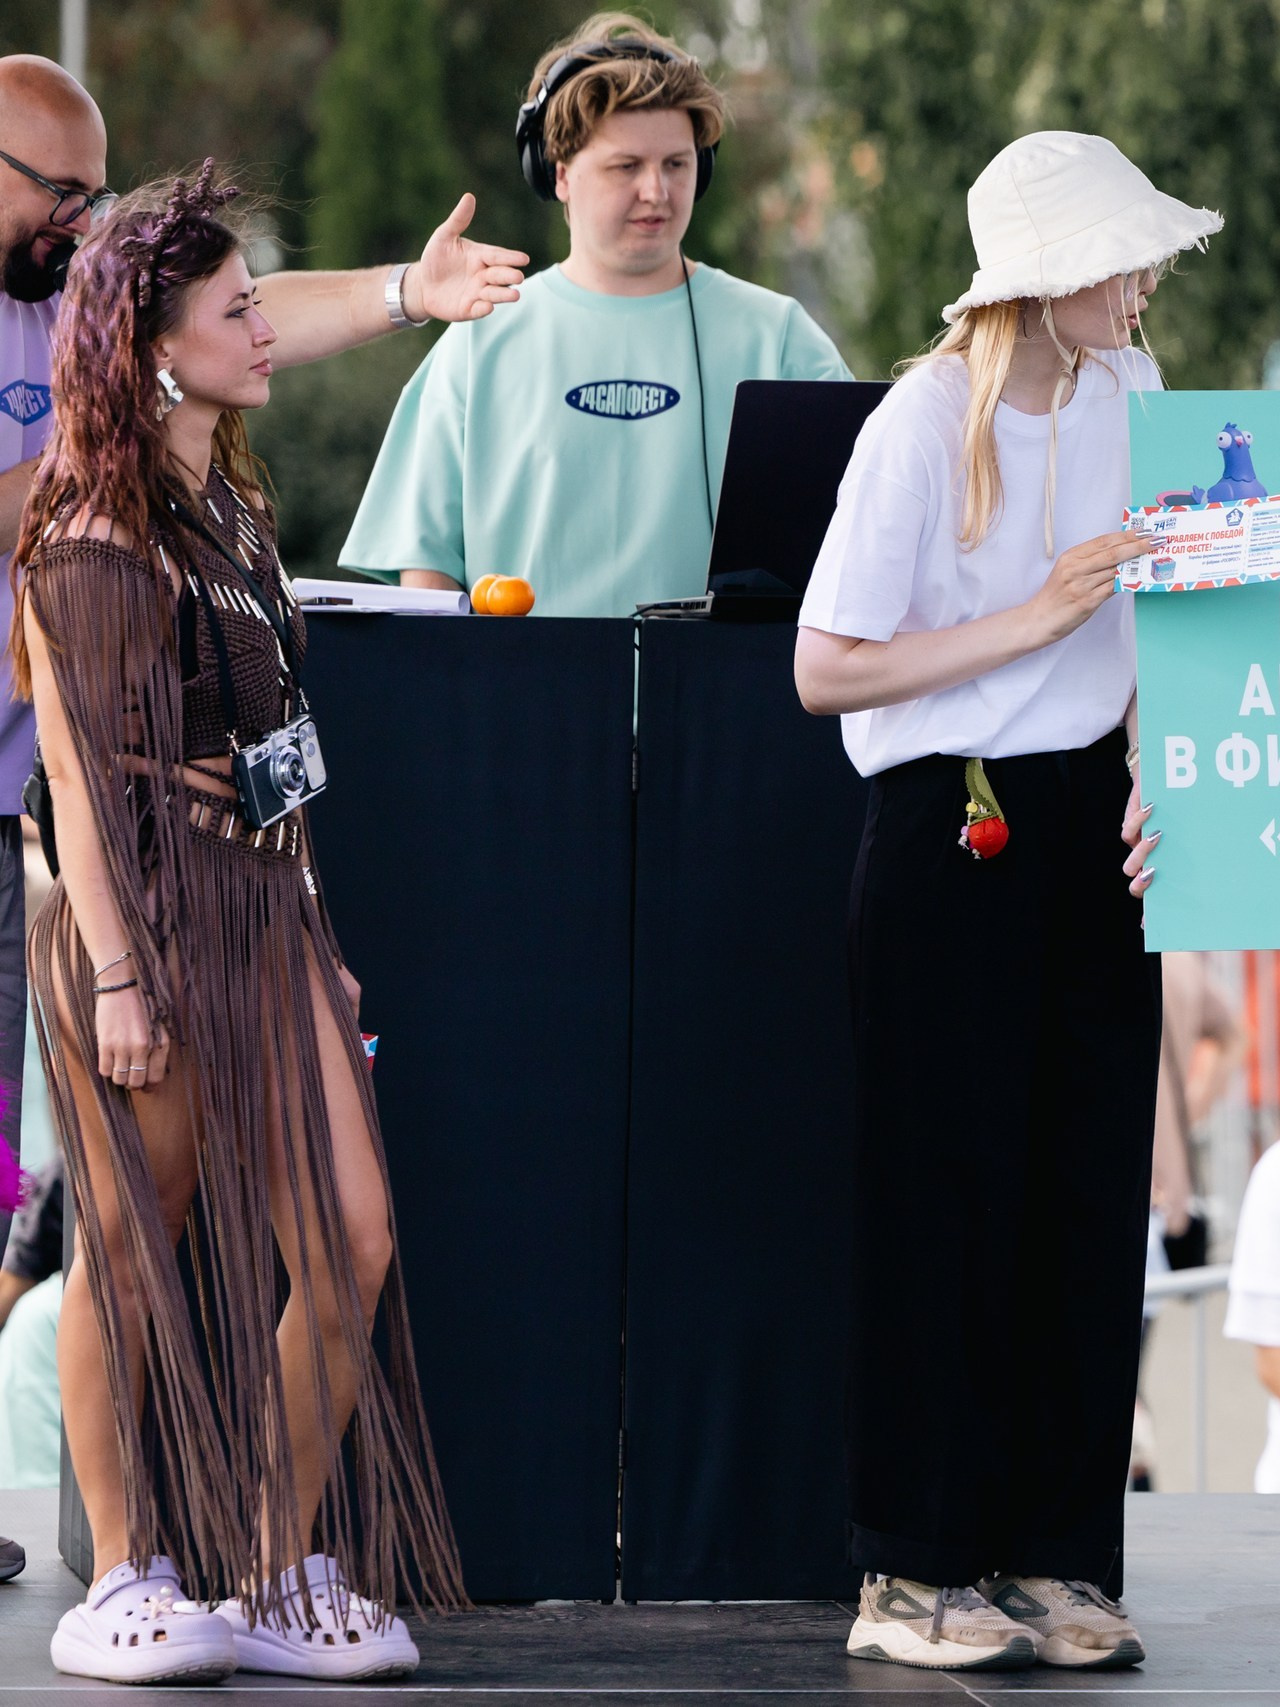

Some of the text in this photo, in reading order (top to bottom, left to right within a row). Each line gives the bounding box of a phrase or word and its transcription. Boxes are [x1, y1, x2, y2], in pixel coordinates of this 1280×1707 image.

[578, 382, 668, 416] 74САПФЕСТ
[1154, 521, 1166, 532] 74
[1166, 532, 1204, 544] ДРАВЛЯЕМ
[1205, 532, 1210, 540] С
[1210, 527, 1244, 539] ПОБЕДОЙ
[1161, 546, 1170, 554] 74
[1171, 545, 1185, 554] САП
[1186, 543, 1212, 553] ФЕСТЕ!
[1164, 736, 1197, 788] В
